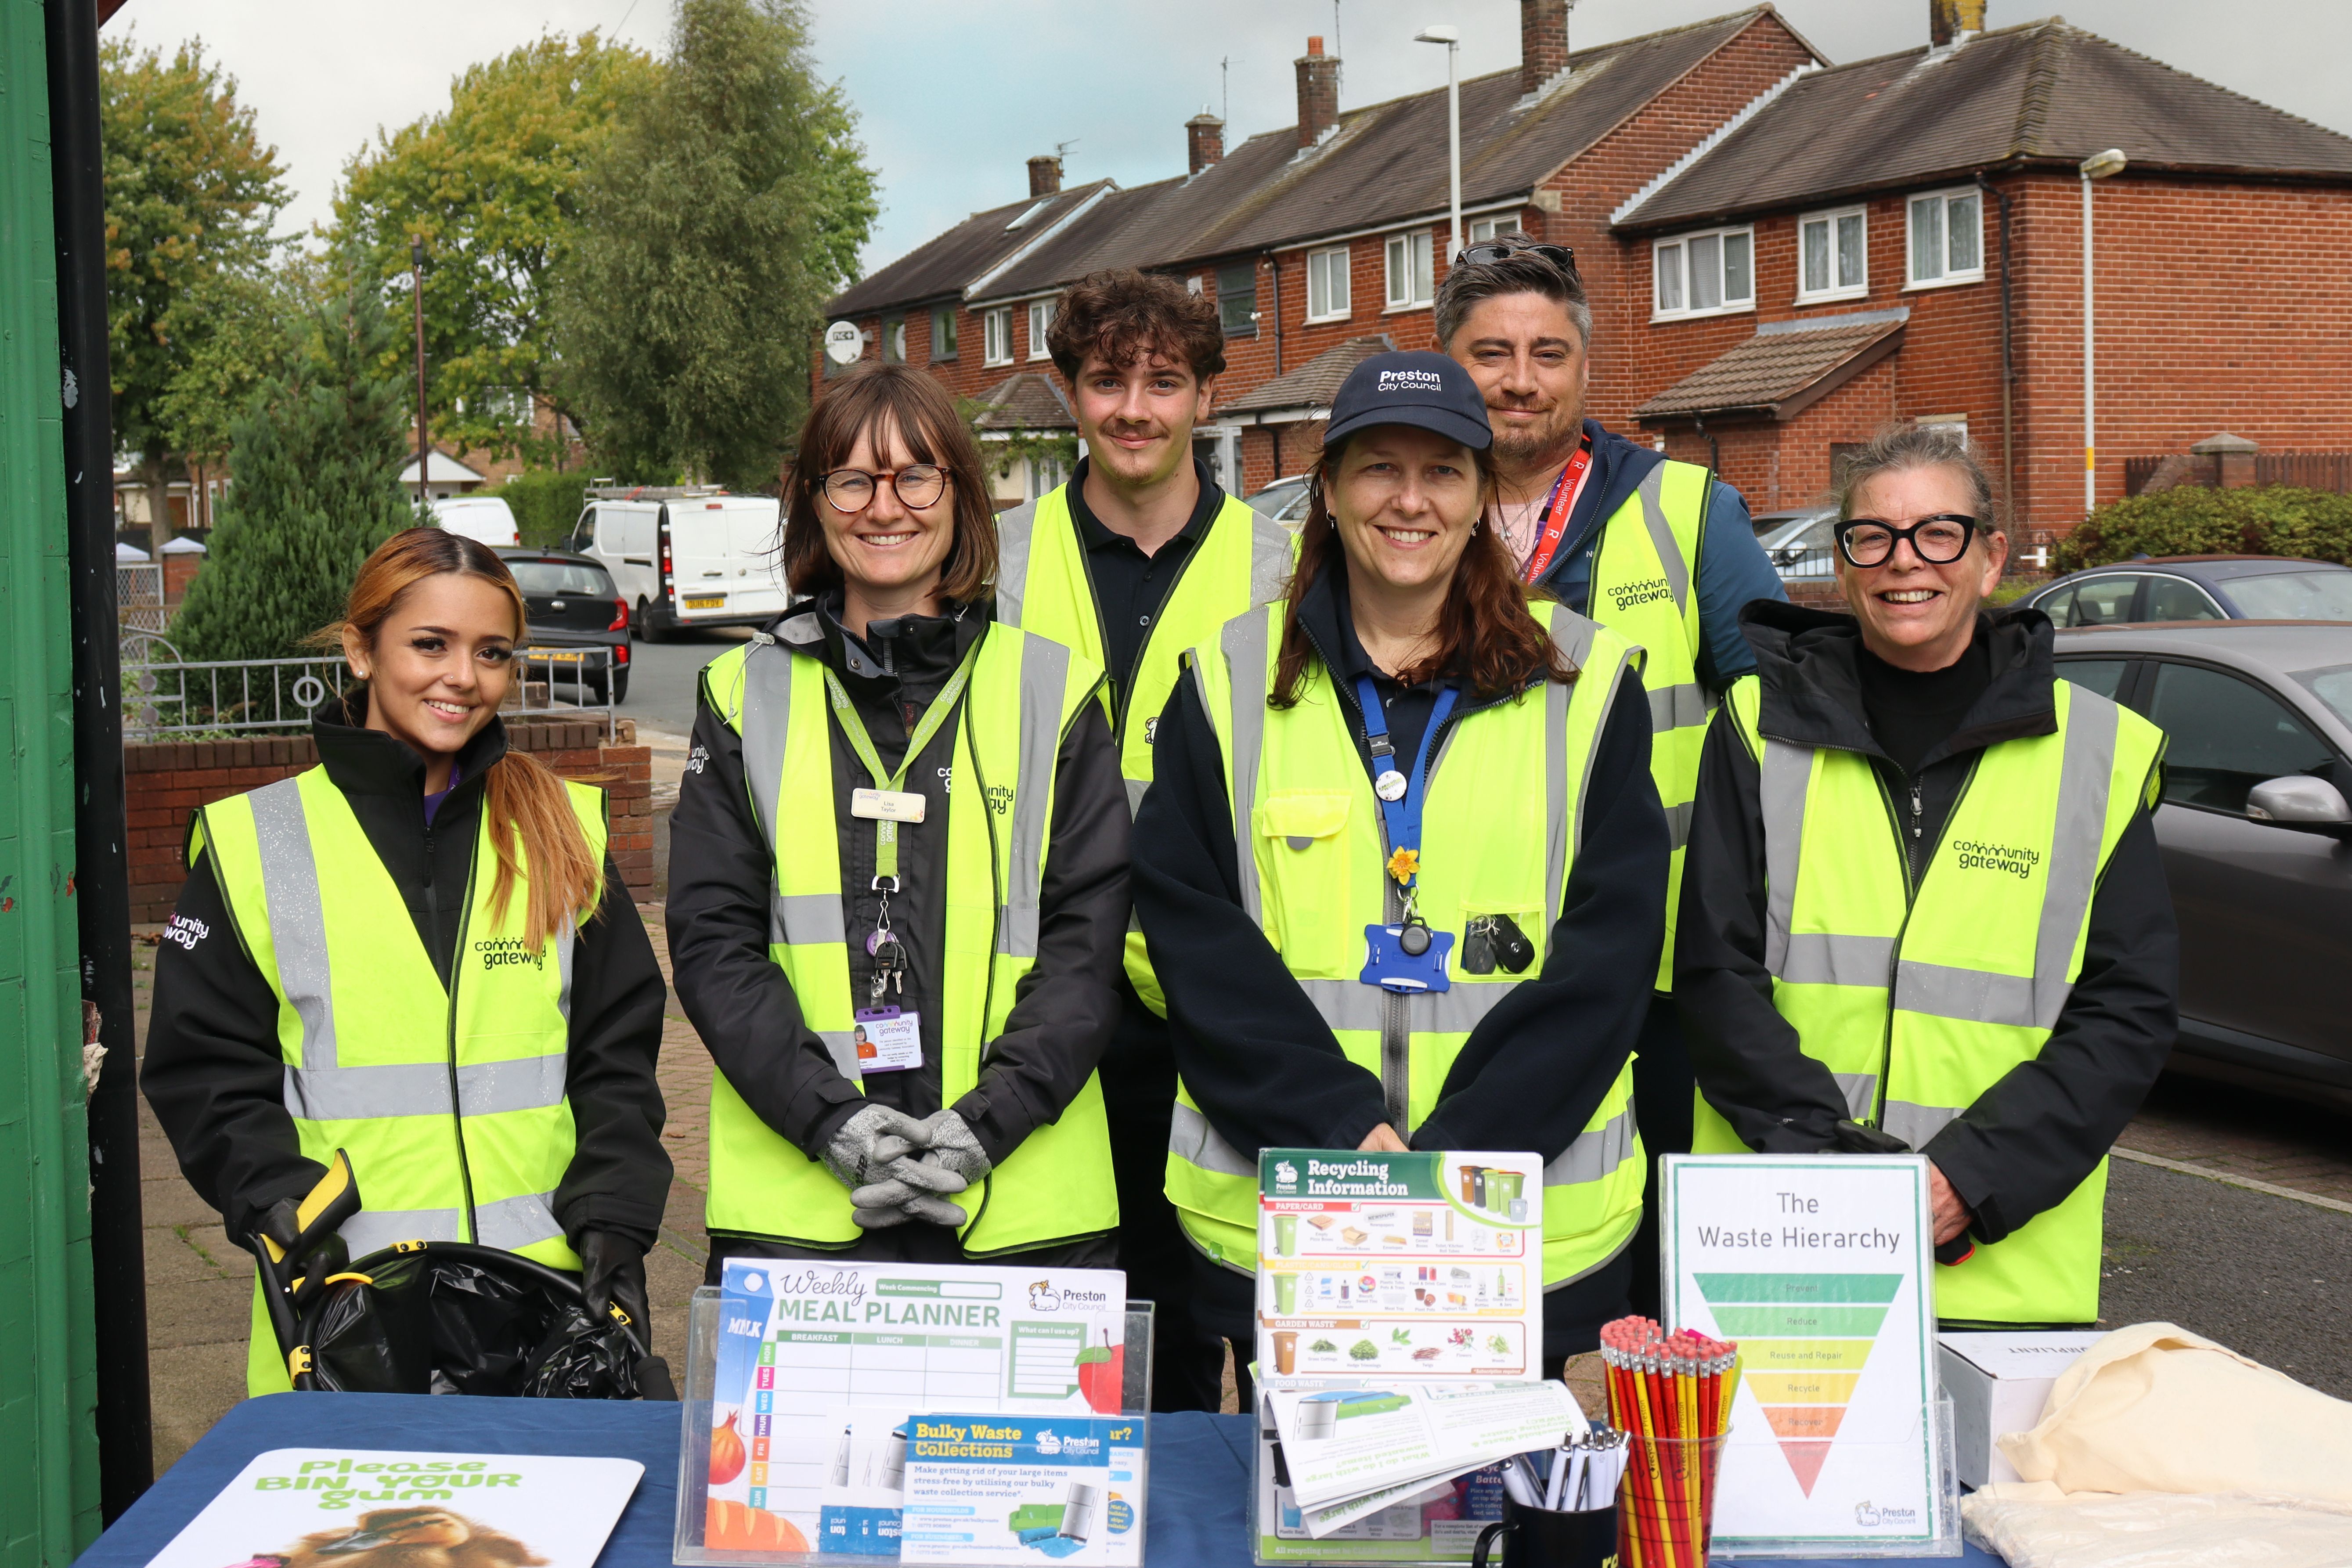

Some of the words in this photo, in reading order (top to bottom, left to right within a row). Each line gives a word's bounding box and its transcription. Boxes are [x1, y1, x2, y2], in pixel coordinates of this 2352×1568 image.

[1380, 370, 1441, 382] Preston
[1378, 382, 1399, 391] City
[1401, 381, 1441, 391] Council
[1555, 479, 1576, 515] Volunteer
[1616, 588, 1675, 611] gateway
[827, 674, 850, 709] community
[691, 744, 710, 761] unity
[1953, 840, 2039, 865] community
[1959, 854, 2030, 879] gateway
[175, 916, 209, 939] unity
[875, 1019, 913, 1029] community
[879, 1026, 910, 1036] gateway
[1308, 1159, 1389, 1180] Recycling
[1307, 1179, 1409, 1196] Information
[1776, 1192, 1819, 1214] The
[1368, 1212, 1395, 1221] NEWSPAPER
[1698, 1227, 1772, 1248] Waste
[1782, 1226, 1900, 1254] Hierarchy
[780, 1270, 868, 1306] Weekly
[897, 1284, 938, 1293] Commencing
[1785, 1283, 1818, 1293] Prevent
[1063, 1289, 1106, 1302] Preston
[778, 1299, 857, 1323] MEAL
[865, 1301, 1000, 1327] PLANNER
[1062, 1302, 1077, 1312] City
[1078, 1303, 1106, 1311] Council
[1786, 1316, 1817, 1326] Reduce
[791, 1334, 838, 1342] BREAKFAST
[1067, 1327, 1080, 1336] up?
[949, 1339, 979, 1347] DINNER
[1770, 1351, 1796, 1360] Reuse
[1798, 1351, 1813, 1360] and
[1815, 1351, 1842, 1362] Repair
[761, 1368, 770, 1388] TUES
[1787, 1384, 1820, 1395] Recycle
[1639, 1399, 1649, 1427] Preston
[1720, 1395, 1728, 1421] Preston
[1519, 1419, 1572, 1432] Recycling
[1526, 1414, 1569, 1424] (HWRC)
[1788, 1417, 1822, 1427] Recover
[916, 1423, 967, 1442] Bulky
[970, 1425, 1022, 1440] Waste
[1480, 1429, 1517, 1438] Centre
[1517, 1426, 1574, 1440] Household
[1063, 1436, 1100, 1447] Preston
[1482, 1436, 1514, 1446] Waste
[915, 1441, 1013, 1458] Collections
[1374, 1444, 1428, 1460] unwanted
[1646, 1442, 1655, 1466] recycle
[1336, 1456, 1371, 1469] items?
[1401, 1451, 1431, 1463] What
[299, 1458, 488, 1474] Please
[939, 1467, 970, 1476] getting
[1019, 1468, 1042, 1478] large
[1335, 1466, 1360, 1477] with
[255, 1475, 349, 1492] BIN
[377, 1473, 523, 1489] YOUR
[963, 1478, 973, 1486] by
[975, 1479, 1012, 1488] utilising
[1031, 1480, 1055, 1489] bulky
[1305, 1472, 1334, 1483] large
[317, 1488, 453, 1511] gum
[1347, 1496, 1371, 1512] with
[1319, 1506, 1346, 1524] large
[1882, 1507, 1915, 1518] Preston
[1287, 1547, 1322, 1555] recycling
